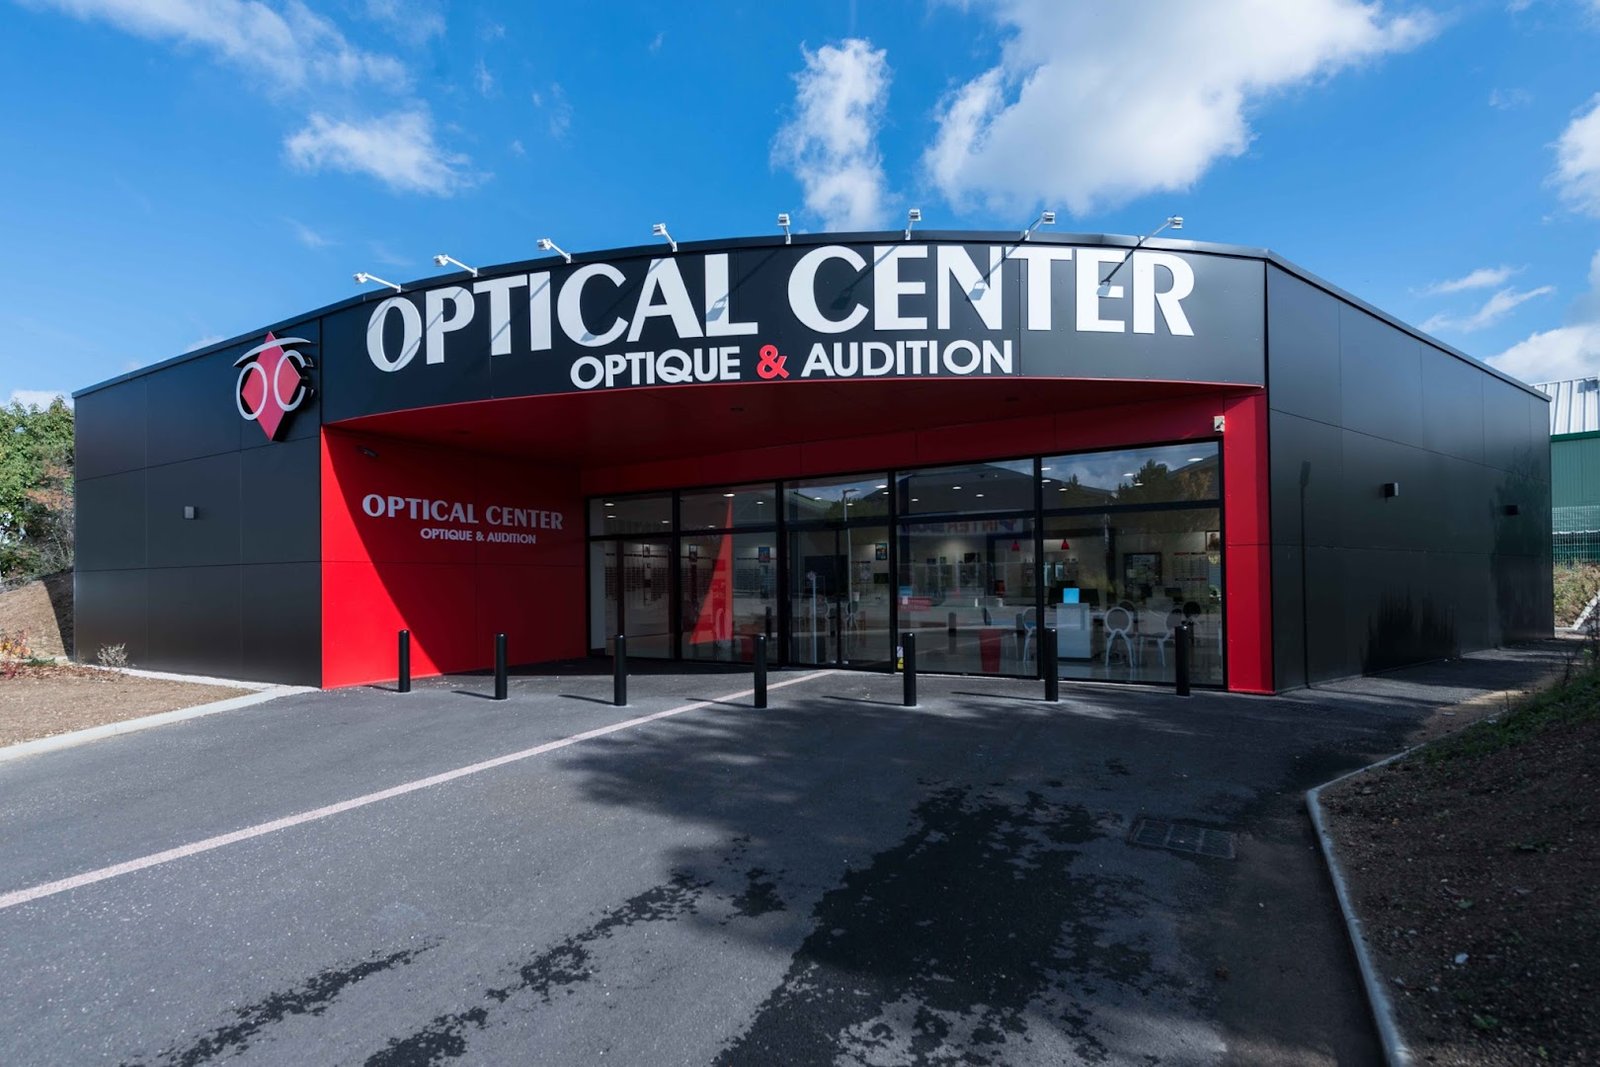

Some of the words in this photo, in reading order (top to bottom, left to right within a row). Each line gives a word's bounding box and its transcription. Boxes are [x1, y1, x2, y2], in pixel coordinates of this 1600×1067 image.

[366, 253, 758, 373] OPTICAL
[788, 245, 1195, 336] CENTER
[570, 346, 741, 389] OPTIQUE
[756, 344, 790, 380] &
[801, 340, 1013, 378] AUDITION
[362, 493, 479, 524] OPTICAL
[485, 506, 564, 530] CENTER
[420, 527, 473, 542] OPTIQUE
[475, 531, 485, 542] &
[487, 532, 536, 544] AUDITION
